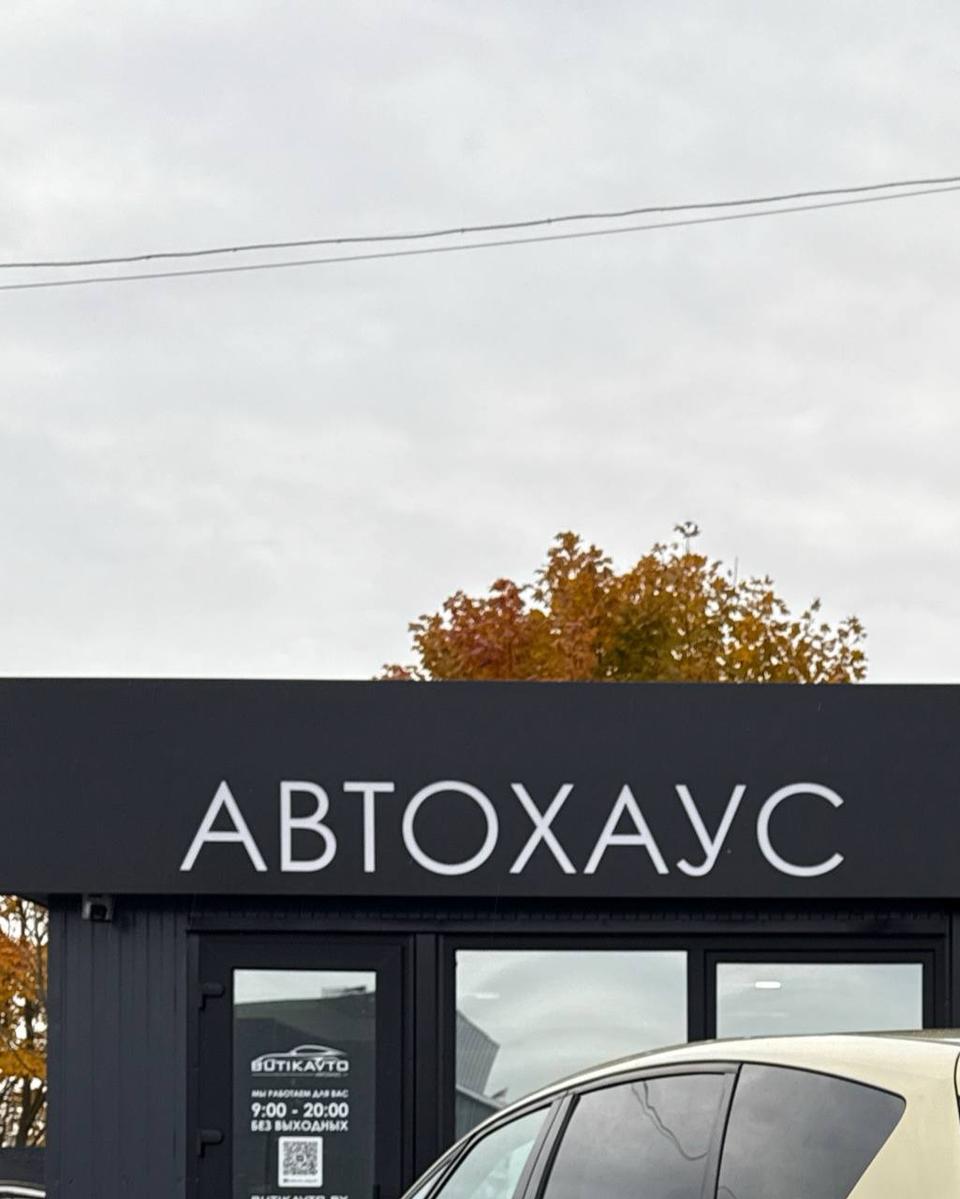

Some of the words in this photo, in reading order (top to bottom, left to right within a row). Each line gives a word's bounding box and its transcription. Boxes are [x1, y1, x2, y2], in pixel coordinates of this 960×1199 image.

[180, 780, 845, 877] АВТОХАУС
[251, 1059, 349, 1072] BUTIKAVTO
[251, 1102, 287, 1118] 9:00
[303, 1102, 349, 1118] 20:00
[251, 1120, 272, 1131] БЕЗ
[274, 1120, 349, 1132] ВЫХОДНЫХ
